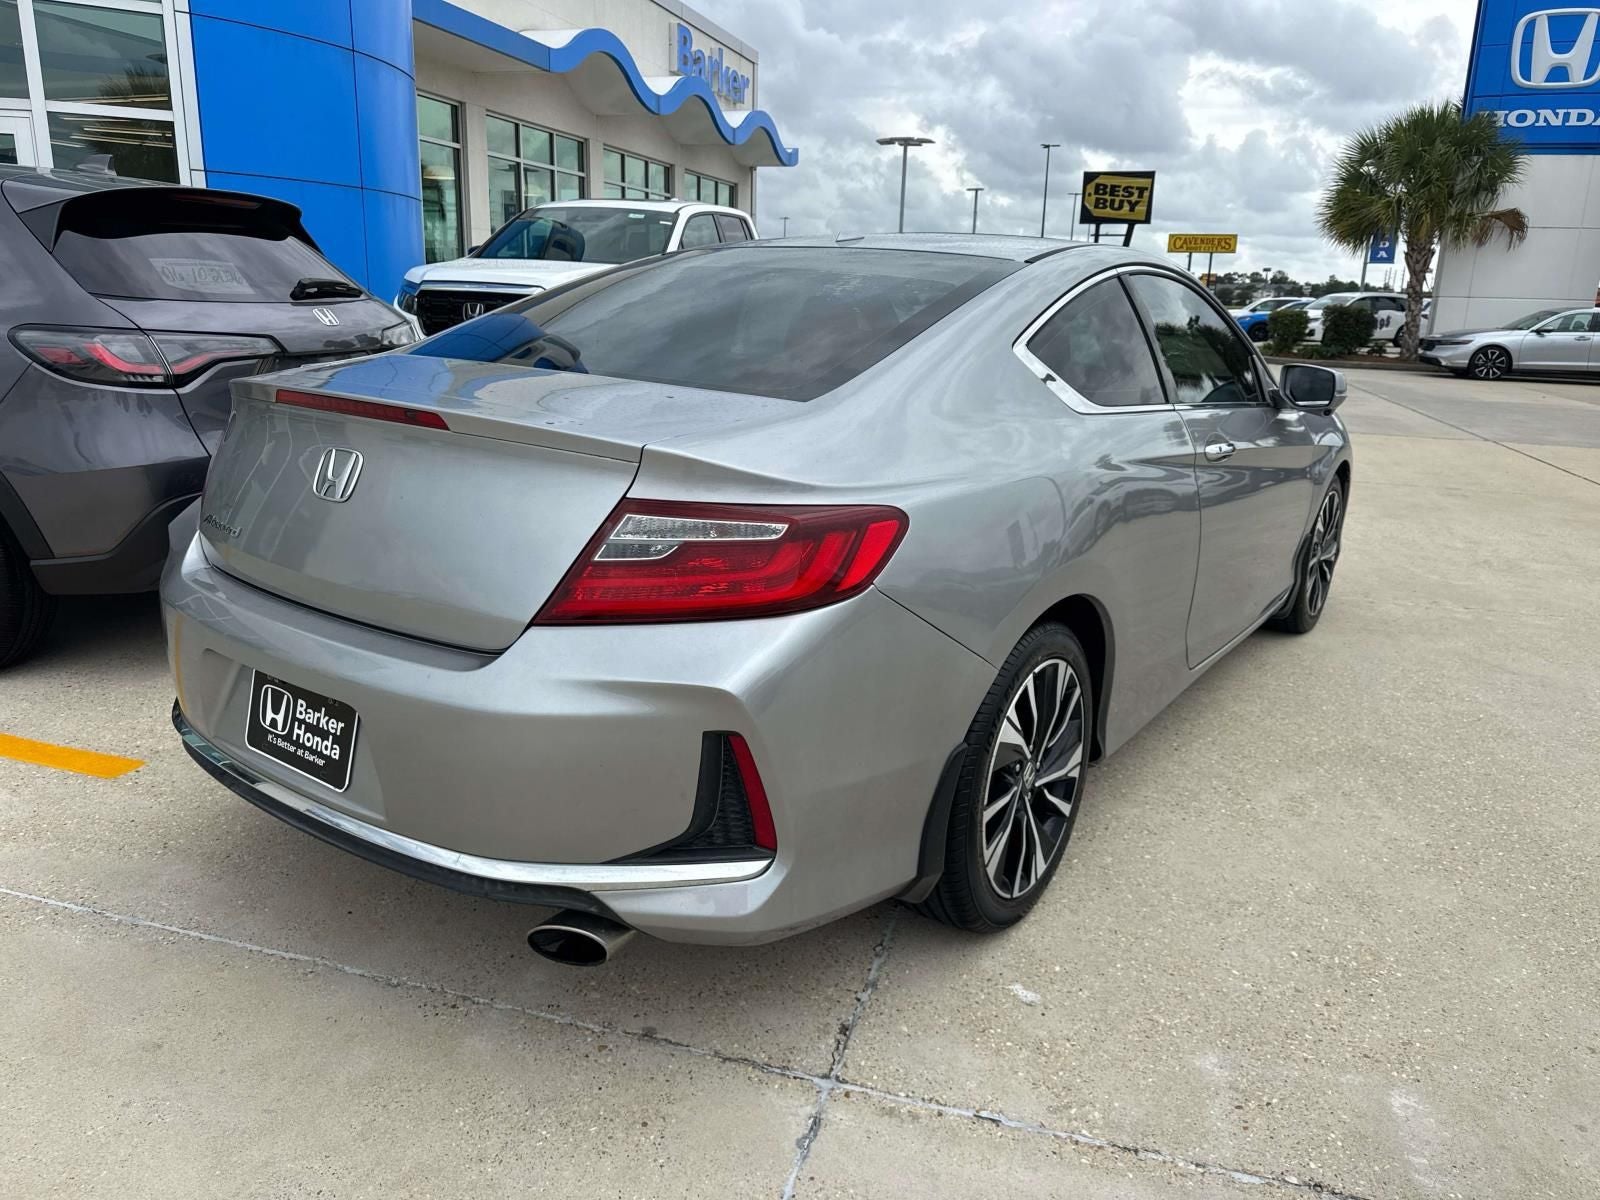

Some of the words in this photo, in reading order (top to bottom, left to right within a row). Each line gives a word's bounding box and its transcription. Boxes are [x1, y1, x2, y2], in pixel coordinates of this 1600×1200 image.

[676, 22, 750, 104] Barker
[1093, 183, 1149, 199] BEST
[1093, 197, 1141, 212] BUY
[295, 699, 345, 736] Barker
[267, 733, 278, 744] It's
[276, 738, 297, 753] Better
[296, 747, 304, 757] at
[304, 751, 326, 767] Barker
[292, 721, 341, 760] Honda
